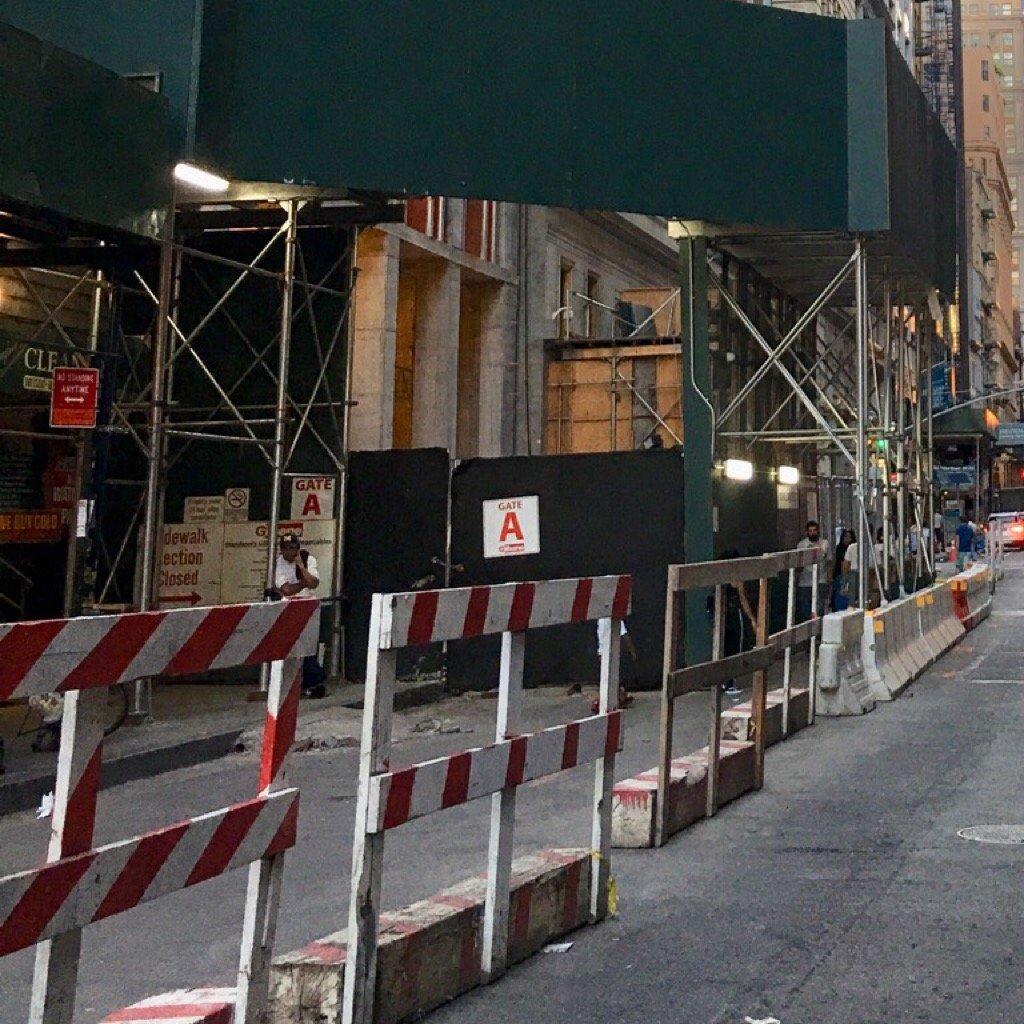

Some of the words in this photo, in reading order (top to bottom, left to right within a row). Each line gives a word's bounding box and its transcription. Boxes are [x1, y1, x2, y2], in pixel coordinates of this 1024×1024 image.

[295, 479, 332, 491] GATE
[302, 493, 321, 516] A
[498, 501, 523, 511] GATE
[499, 512, 525, 541] A
[163, 527, 209, 546] dewalk
[162, 549, 204, 566] ection
